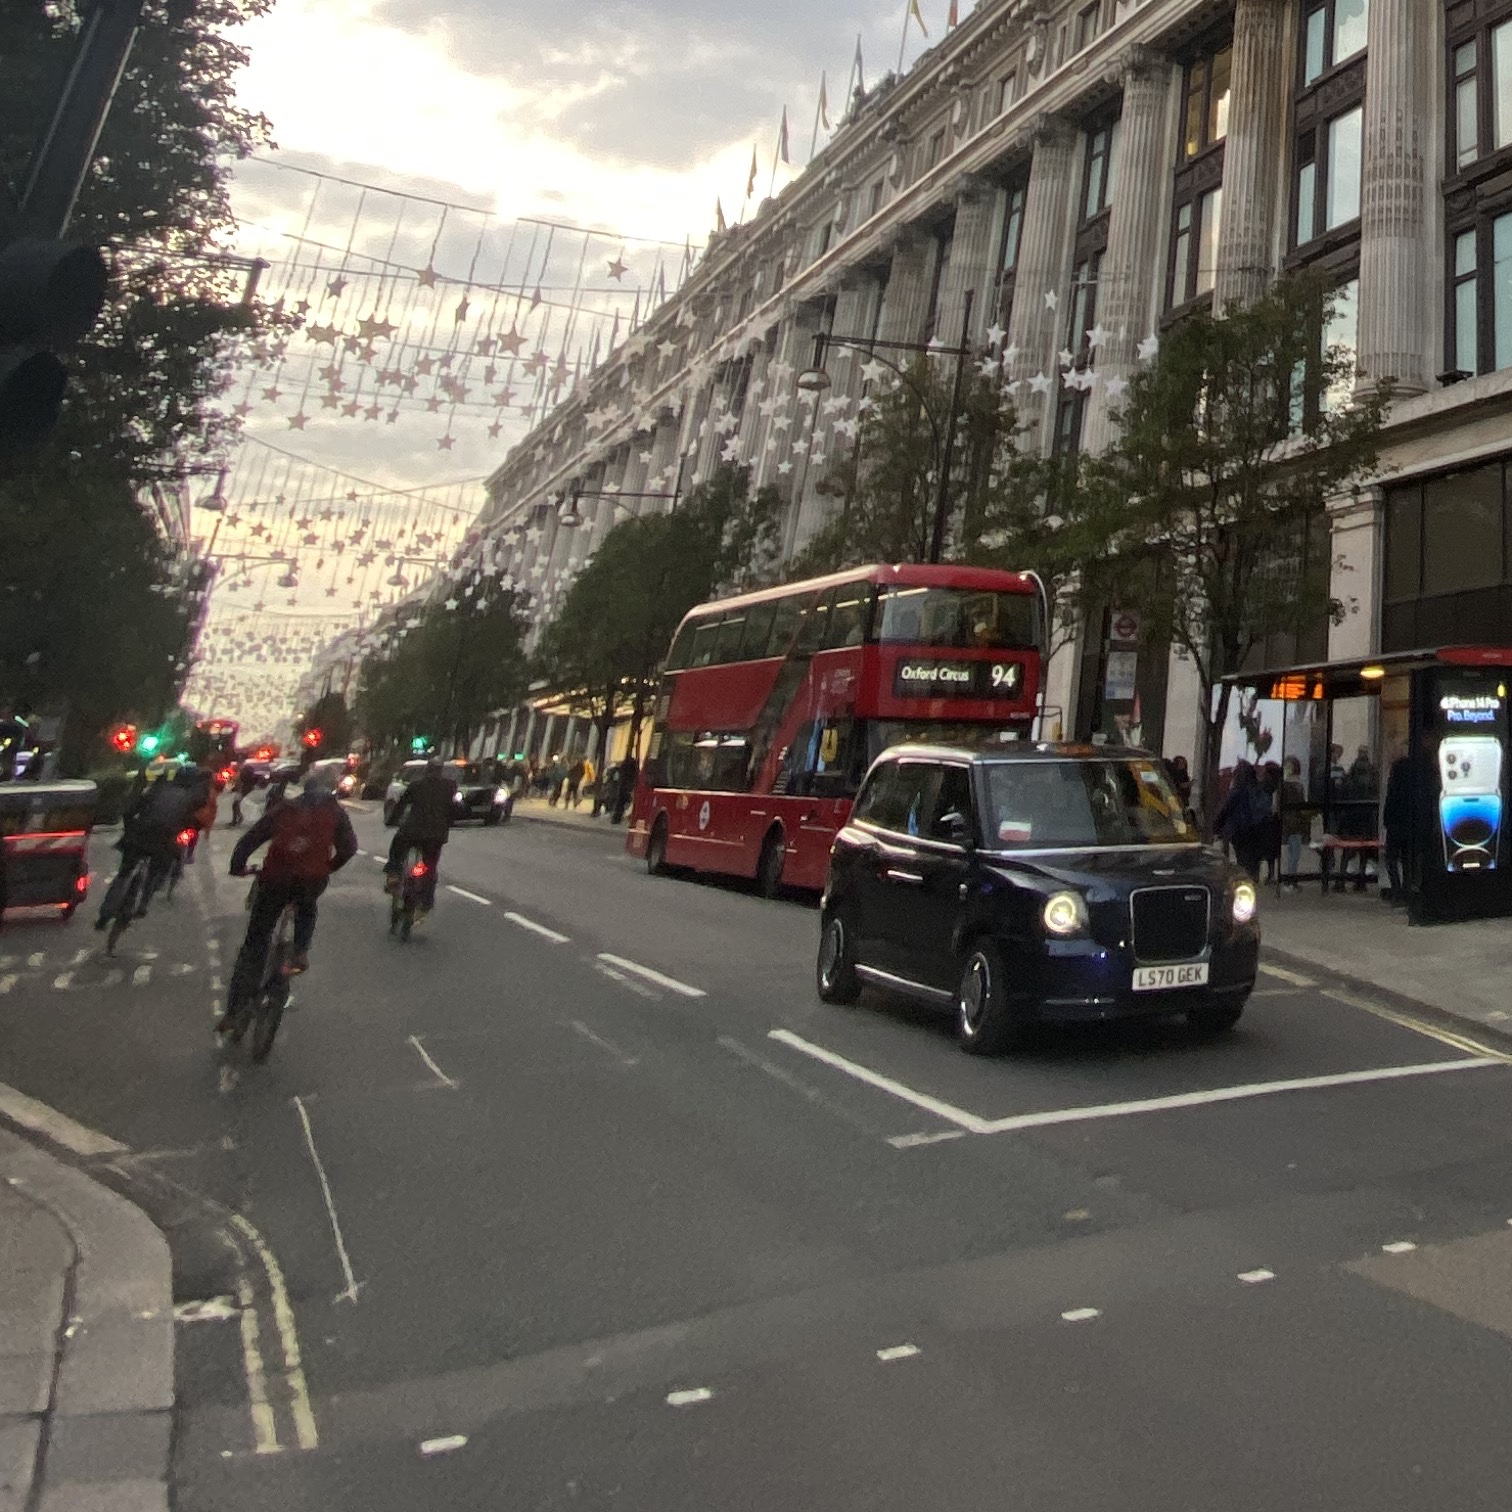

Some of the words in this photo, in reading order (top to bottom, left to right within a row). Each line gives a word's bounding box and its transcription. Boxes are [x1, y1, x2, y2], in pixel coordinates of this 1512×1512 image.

[901, 665, 937, 681] Oxford
[939, 666, 969, 682] Circus
[991, 664, 1016, 688] 94
[1138, 968, 1174, 987] LS70
[1177, 966, 1202, 983] GEK
